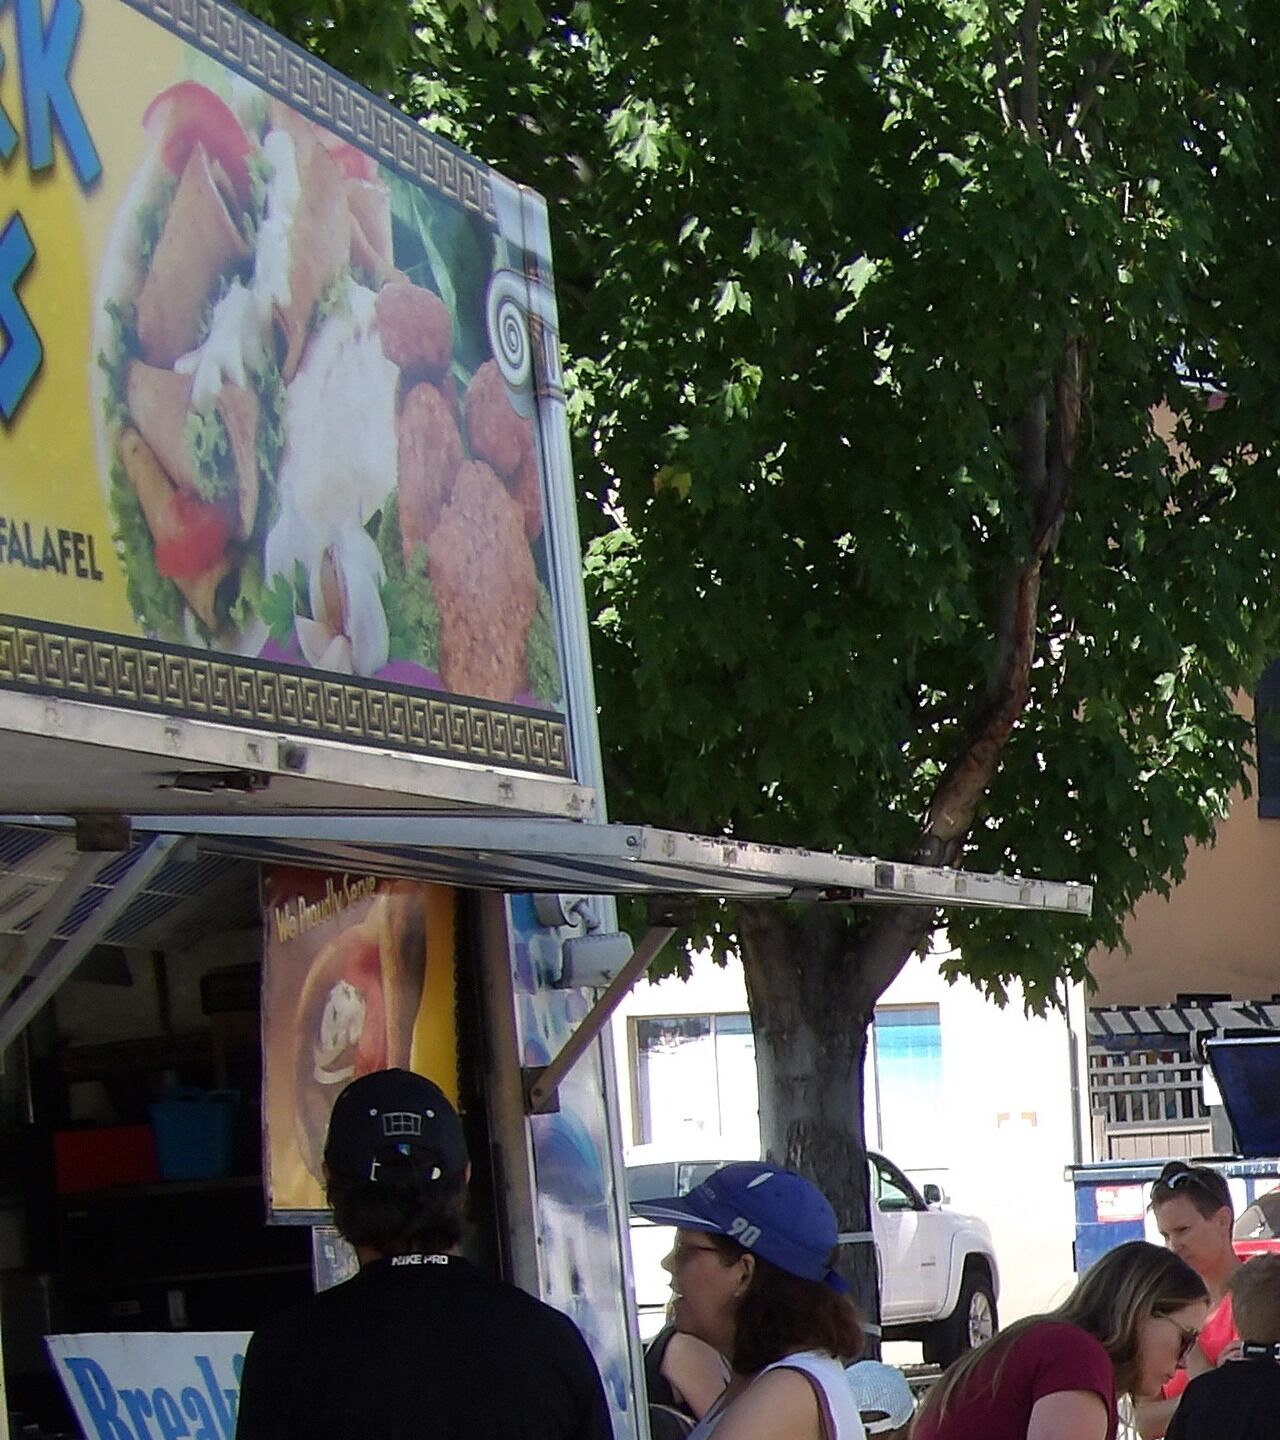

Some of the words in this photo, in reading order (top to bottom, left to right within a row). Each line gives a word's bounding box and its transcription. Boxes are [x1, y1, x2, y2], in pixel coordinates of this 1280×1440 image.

[726, 1216, 762, 1248] 90
[391, 1254, 422, 1266] NIKE
[424, 1254, 450, 1265] PRO
